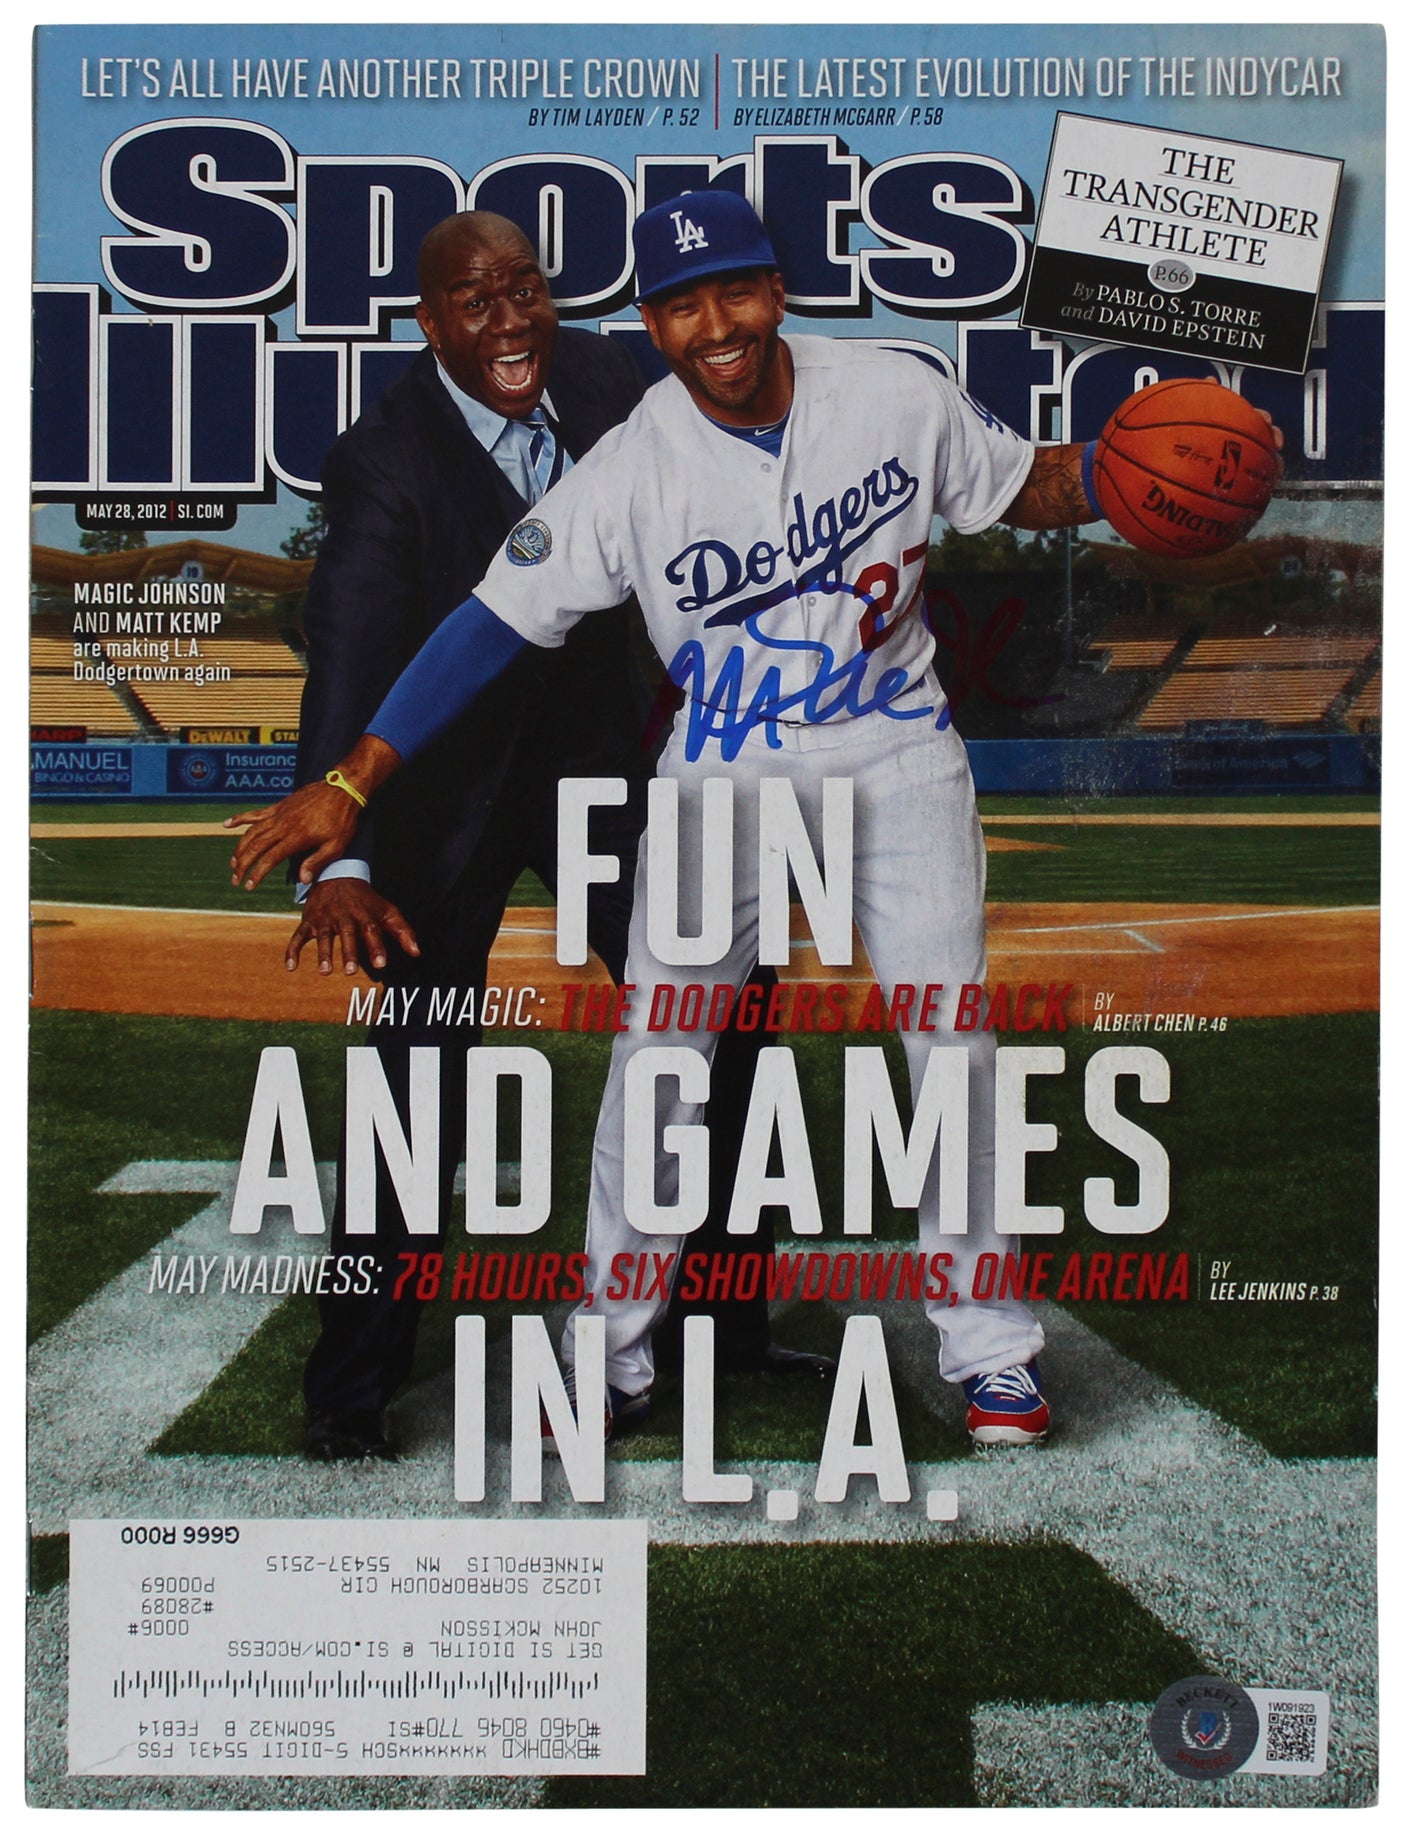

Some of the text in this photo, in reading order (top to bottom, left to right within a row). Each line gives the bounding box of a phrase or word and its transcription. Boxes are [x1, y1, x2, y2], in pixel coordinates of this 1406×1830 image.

[81, 57, 700, 99] LET'S ALL HAVE ANOTHER TRIPLE CROWN
[731, 57, 1342, 98] THE LATEST EVOLUTION OF THE INDYCAR
[528, 107, 549, 127] BY
[552, 107, 581, 127] TIM
[584, 107, 645, 127] LAYDEN
[733, 106, 754, 127] BY
[754, 106, 830, 127] ELIZABETH
[833, 106, 896, 127] MCGARR
[1162, 147, 1236, 185] THE
[1063, 168, 1319, 239] TRANSGENDER
[670, 210, 709, 254] LA
[1099, 213, 1268, 267] ATHLETE
[1072, 281, 1263, 329] By PABLO S. TORRE
[1061, 304, 1266, 351] and DAVID EPSTEIN
[86, 503, 167, 520] MAY 28, 2012
[664, 456, 920, 629] Dodgers
[74, 582, 226, 605] MAGIC JOHNSON
[73, 611, 222, 634] AND MATT KEMP
[73, 637, 204, 662] are making L.A.
[73, 661, 231, 686] Dodgertown again
[35, 752, 129, 770] MANUEL
[34, 772, 74, 784] BINGO
[86, 772, 130, 784] CASINO
[556, 776, 854, 966] FUN
[346, 983, 1074, 1032] MAY MAGIC: THE DODGERS ARE BACK
[1094, 992, 1115, 1010] BY
[1093, 1013, 1152, 1032] ALBERT
[1153, 1013, 1197, 1032] CHEN
[229, 1045, 1172, 1235] AND GAMES
[149, 1252, 1190, 1308] MAY MADNESS: 78 HOURS, SIX SHOWDOWNS, ONE ARENA
[1210, 1261, 1231, 1279] BY
[1210, 1282, 1237, 1301] LEE
[1238, 1282, 1307, 1301] JENKINS
[454, 1314, 959, 1521] IN L.A.
[121, 1525, 240, 1544] G666 R000
[266, 1556, 604, 1573] MINNEAPOLIS MN 55437-2515
[141, 1577, 215, 1593] P00069
[341, 1577, 602, 1594] 10252 SCARBOROUGH CIR
[141, 1598, 215, 1614] #28089
[127, 1619, 189, 1636] 0006#
[441, 1620, 602, 1637] JOHN MCKISSON
[228, 1640, 603, 1658] GET SI DIGITAL @ SI.COM/ACCESS
[1175, 1686, 1240, 1709] BECKETT
[1268, 1701, 1316, 1713] 1W091923
[139, 1720, 198, 1737] FEB14
[225, 1720, 236, 1737] B
[250, 1720, 335, 1737] 560MN32
[478, 1717, 527, 1738] 8046
[541, 1717, 600, 1738] #0460
[138, 1741, 173, 1758] FSS
[189, 1741, 247, 1758] 55431
[263, 1741, 348, 1758] 5-DIGIT
[1175, 1749, 1233, 1771] WITNESSED
